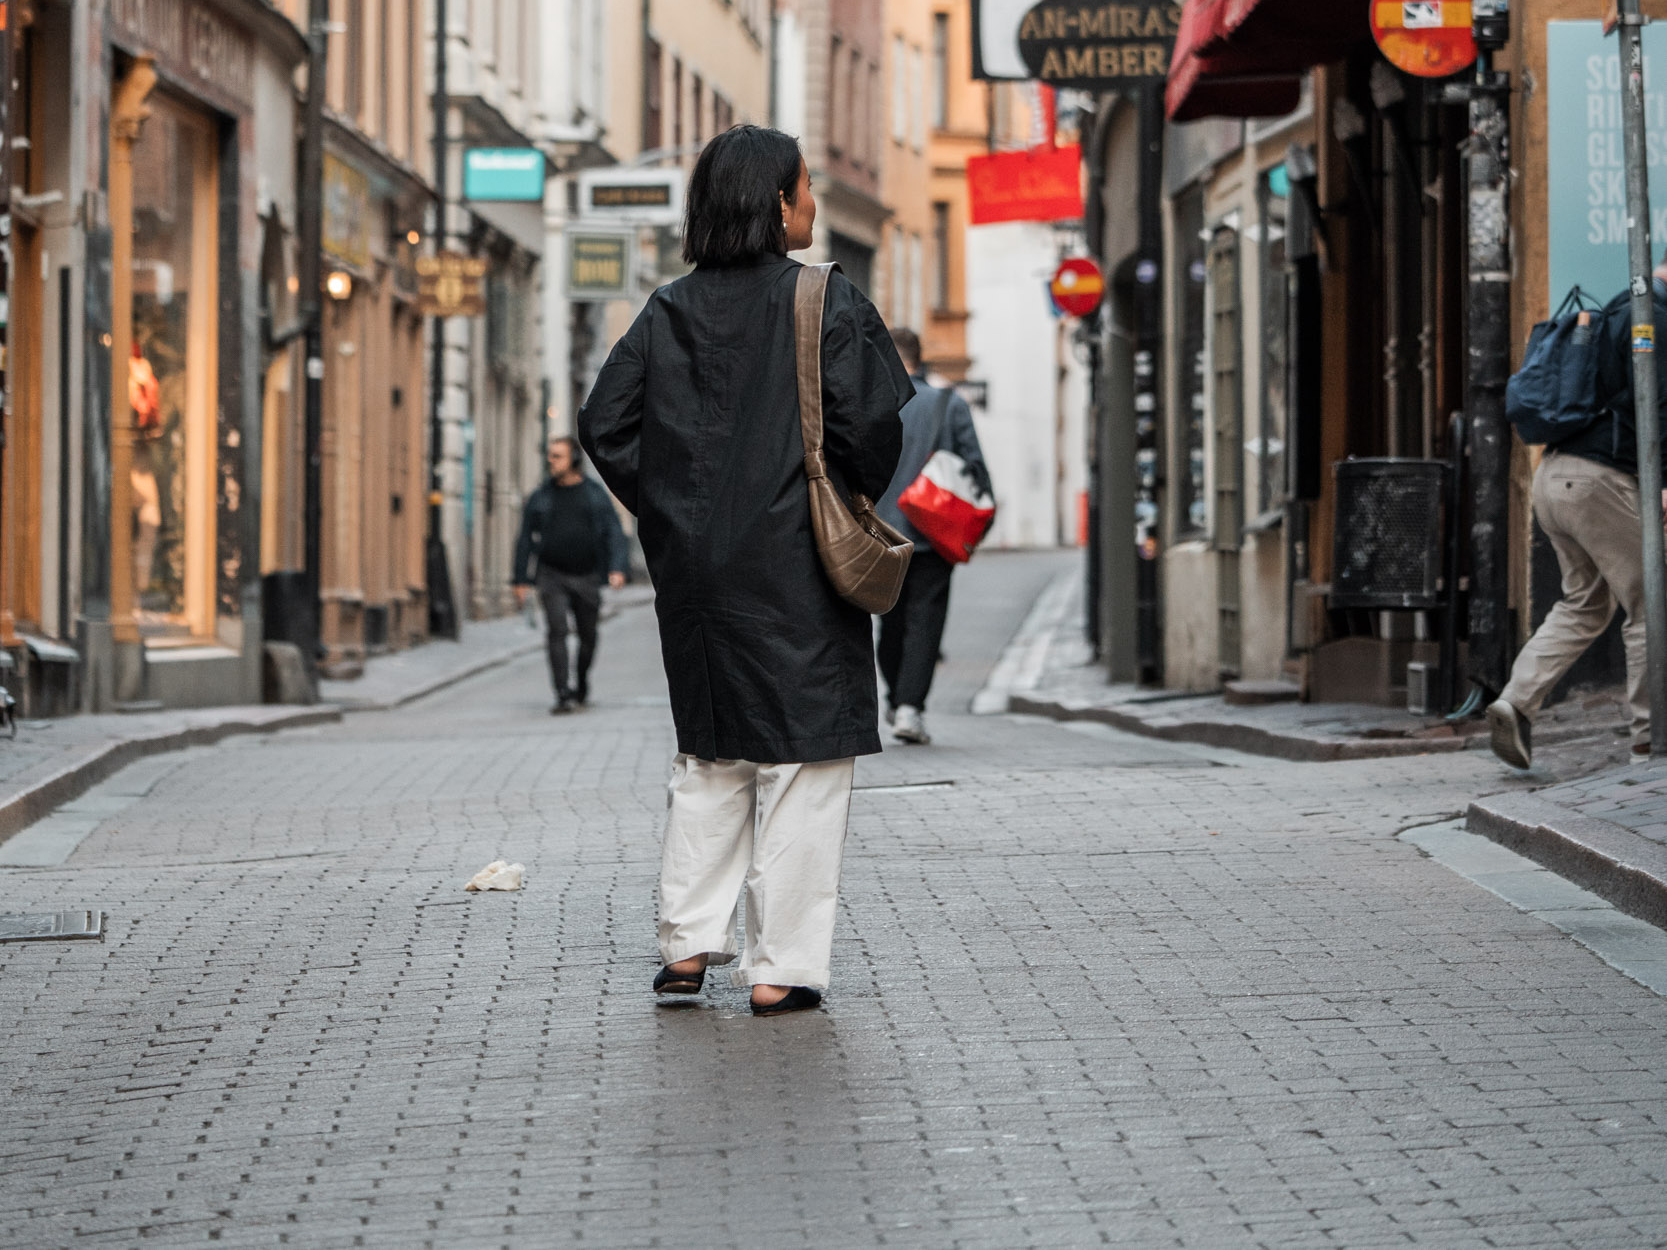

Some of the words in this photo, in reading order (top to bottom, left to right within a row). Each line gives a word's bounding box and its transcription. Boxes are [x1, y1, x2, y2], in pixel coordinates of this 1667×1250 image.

[1040, 43, 1167, 79] AMBER
[1586, 54, 1650, 91] SO
[1588, 209, 1667, 245] SMK
